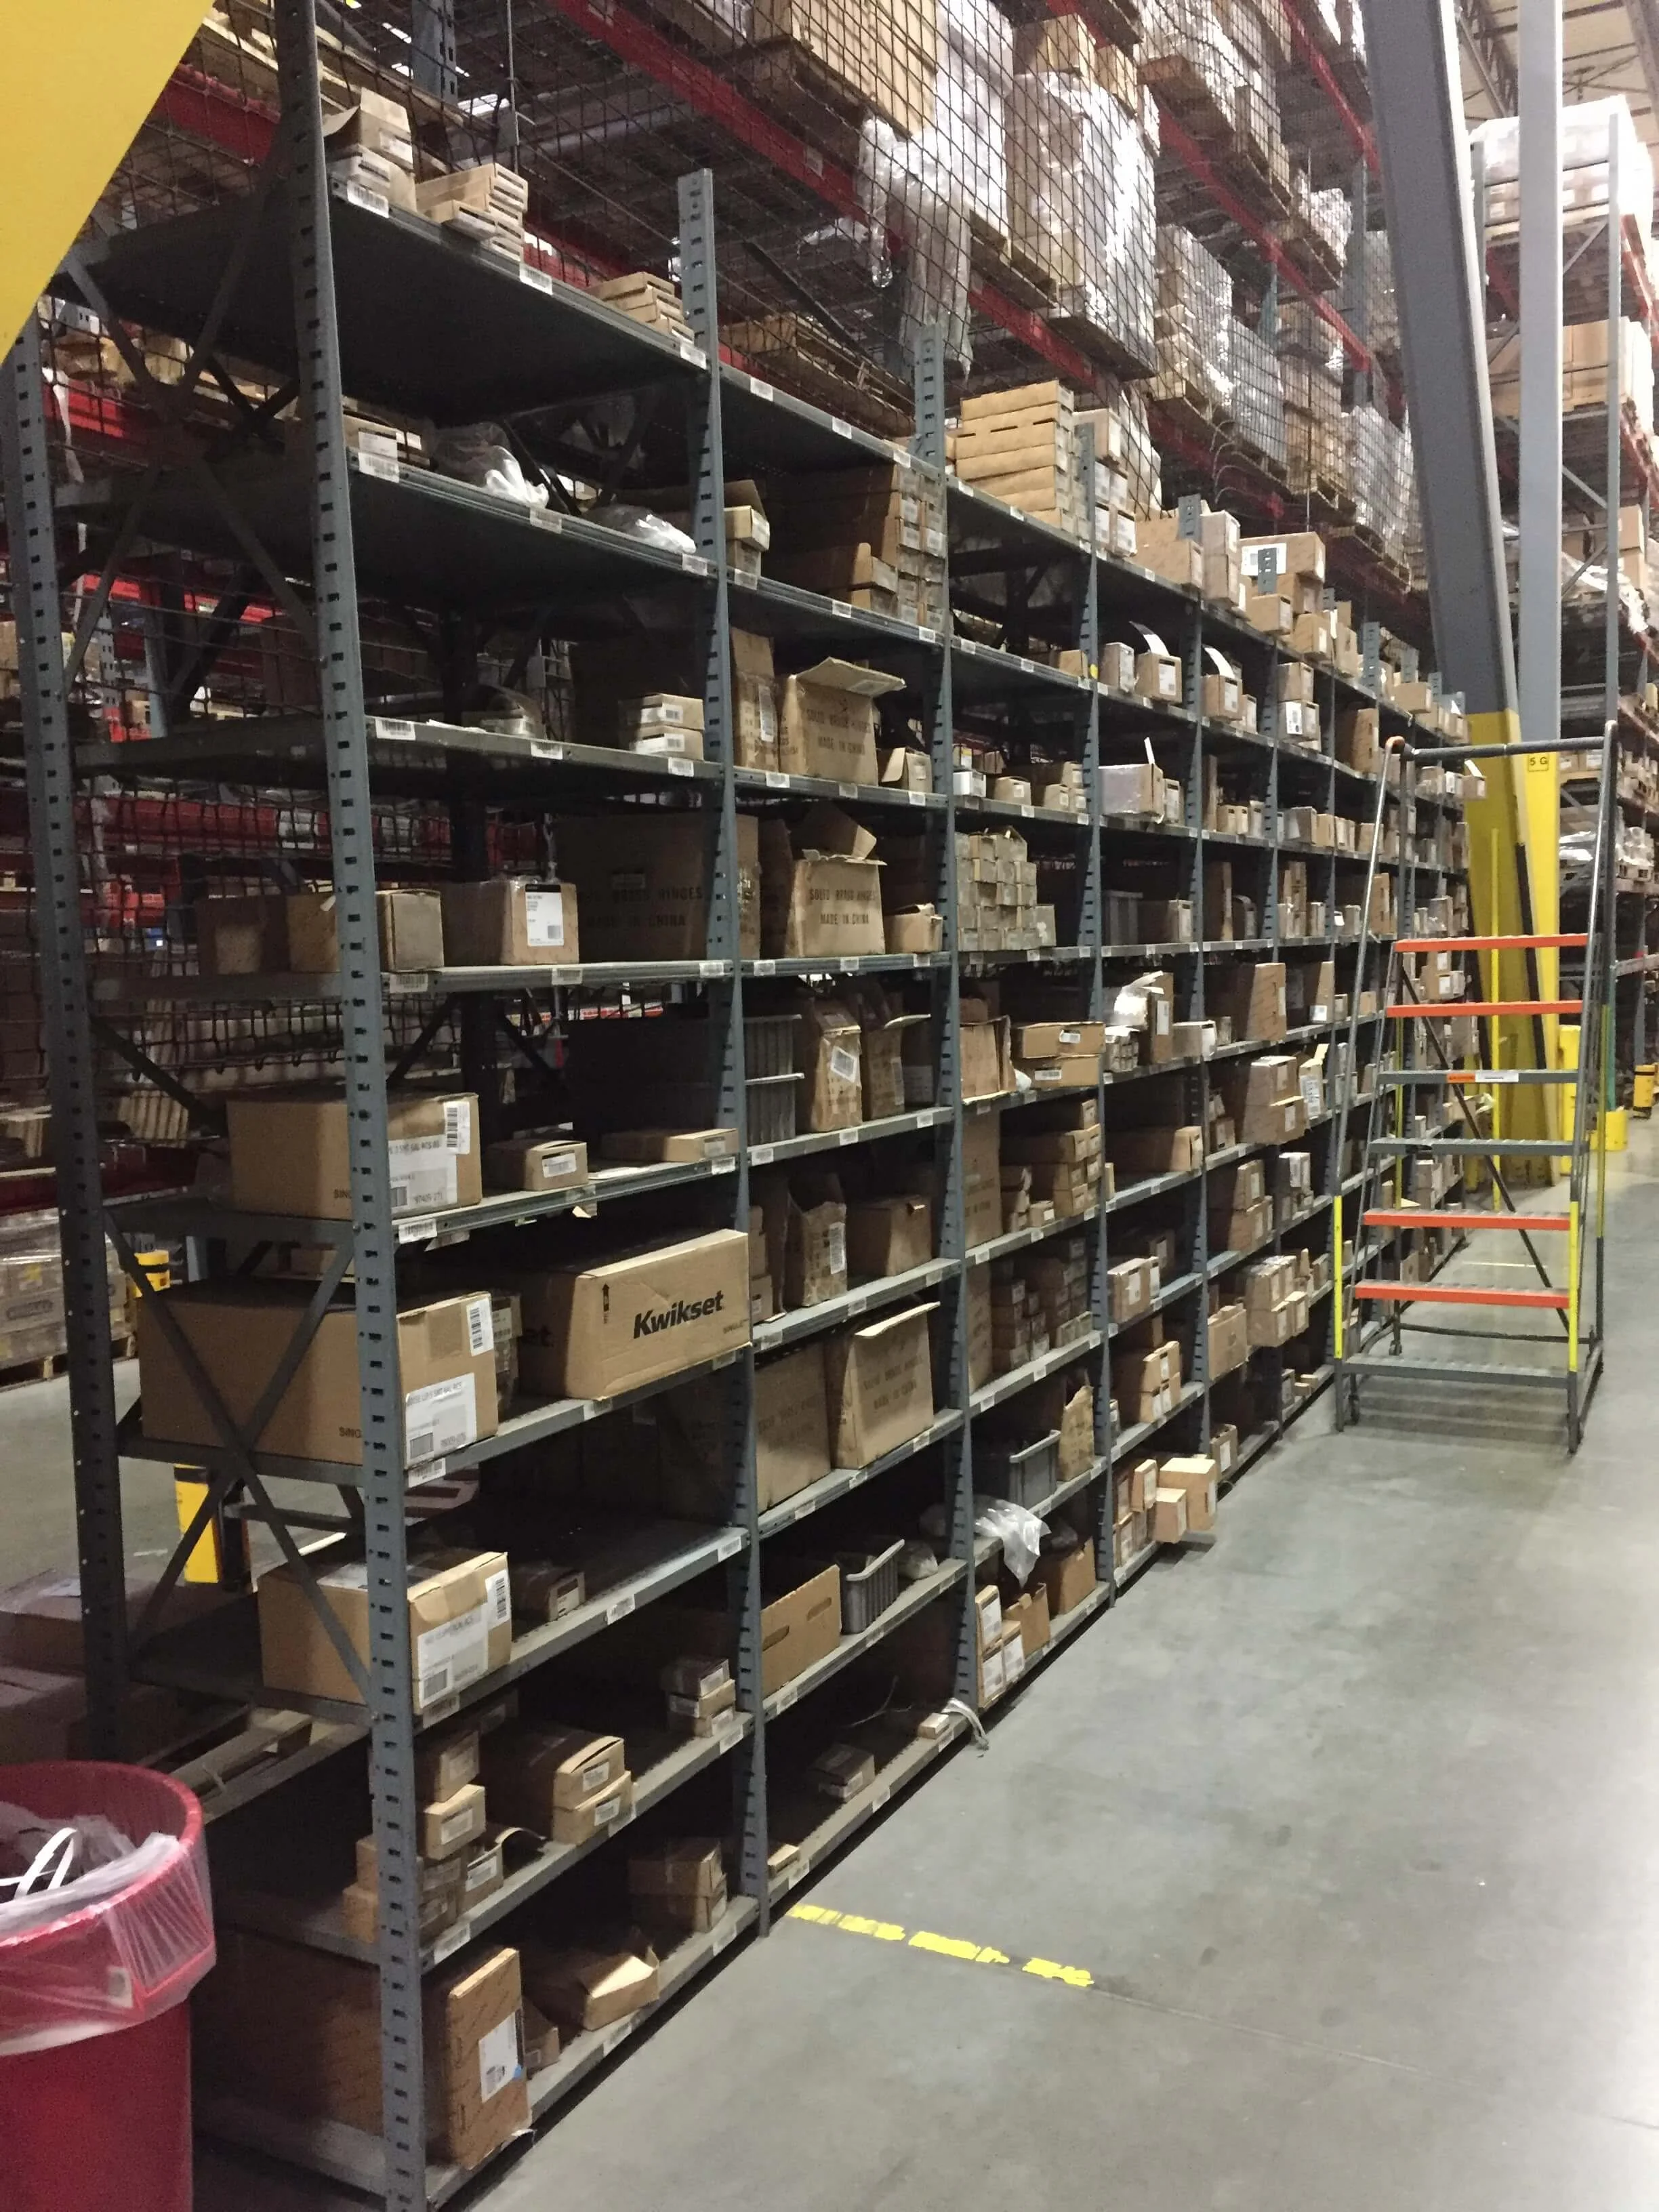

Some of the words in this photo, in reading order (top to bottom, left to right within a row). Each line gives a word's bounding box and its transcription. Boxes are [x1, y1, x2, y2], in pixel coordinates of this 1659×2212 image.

[659, 886, 703, 901] HINGES
[810, 888, 830, 901] SOLID
[648, 914, 687, 927] CHINA
[819, 913, 838, 925] MADE
[842, 913, 849, 924] IN
[634, 1290, 724, 1340] Kwikset
